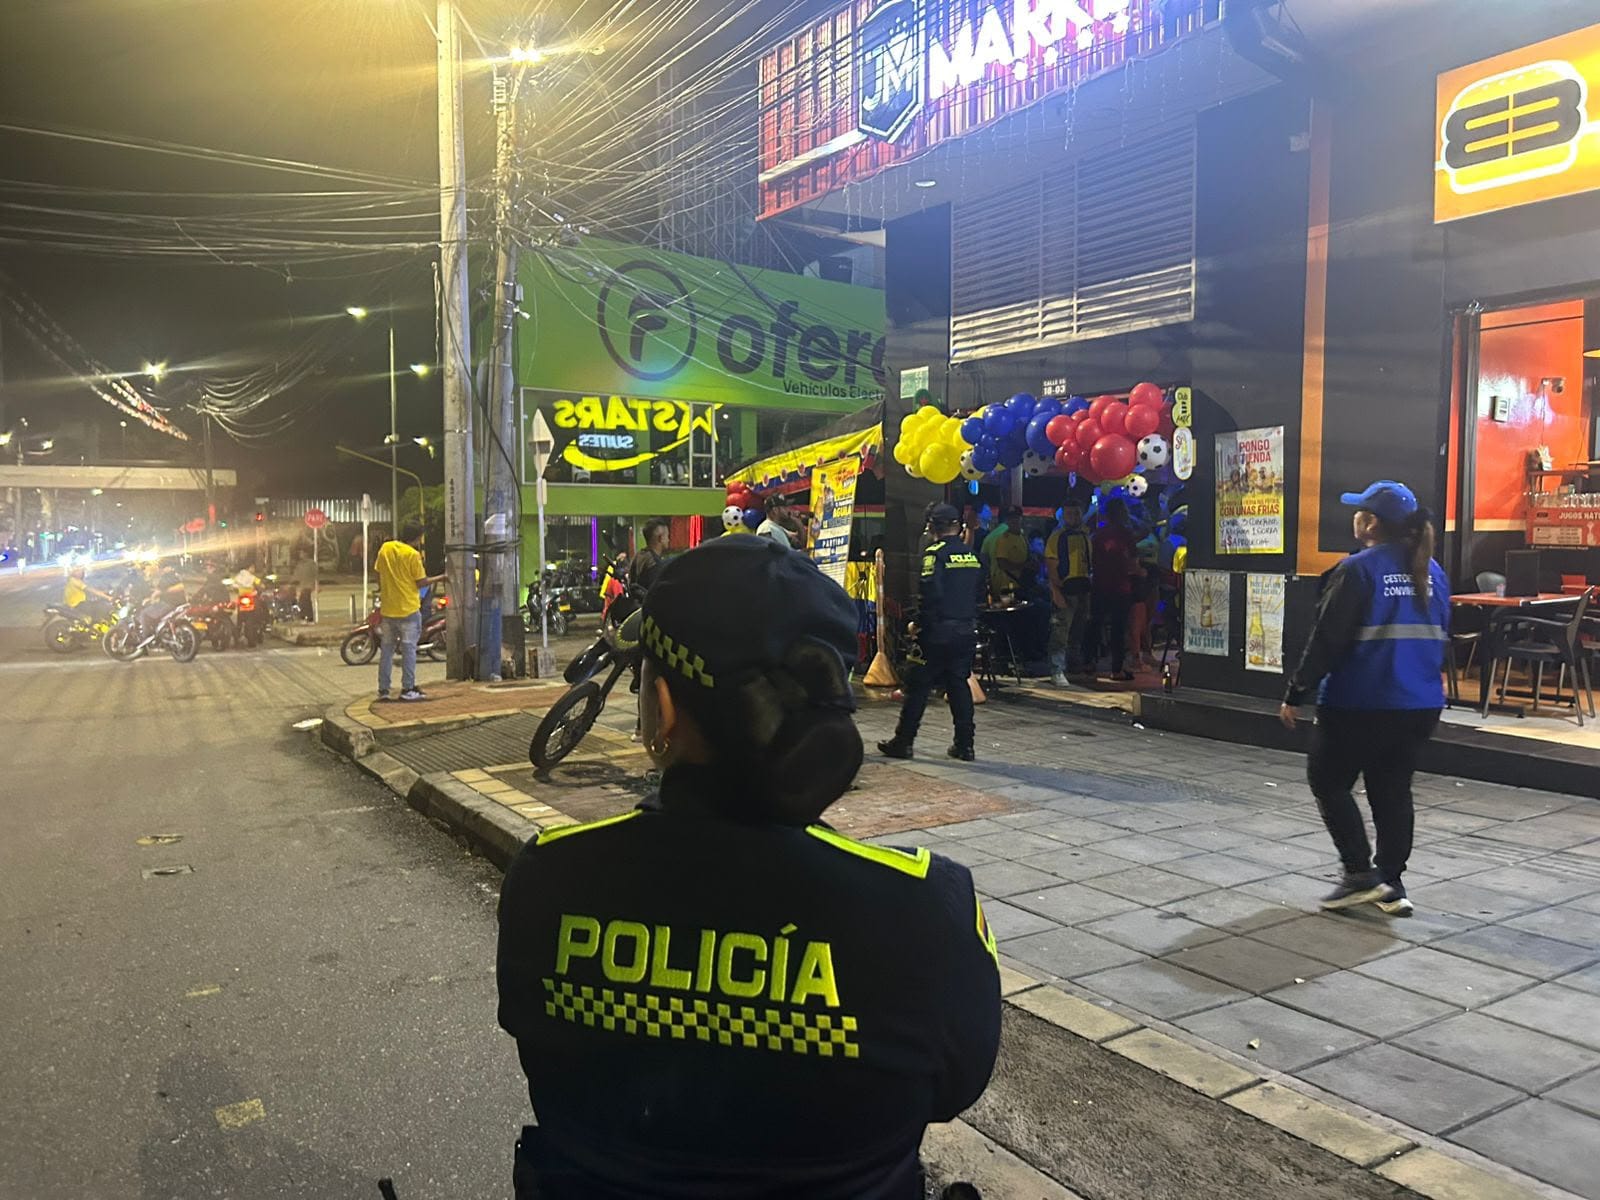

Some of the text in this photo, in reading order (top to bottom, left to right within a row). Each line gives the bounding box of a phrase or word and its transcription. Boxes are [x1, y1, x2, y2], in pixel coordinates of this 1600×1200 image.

[1239, 439, 1270, 452] PONGO
[1240, 451, 1271, 464] TIENDA
[1559, 511, 1583, 520] JUGOS
[555, 914, 840, 1008] POLICÍA
